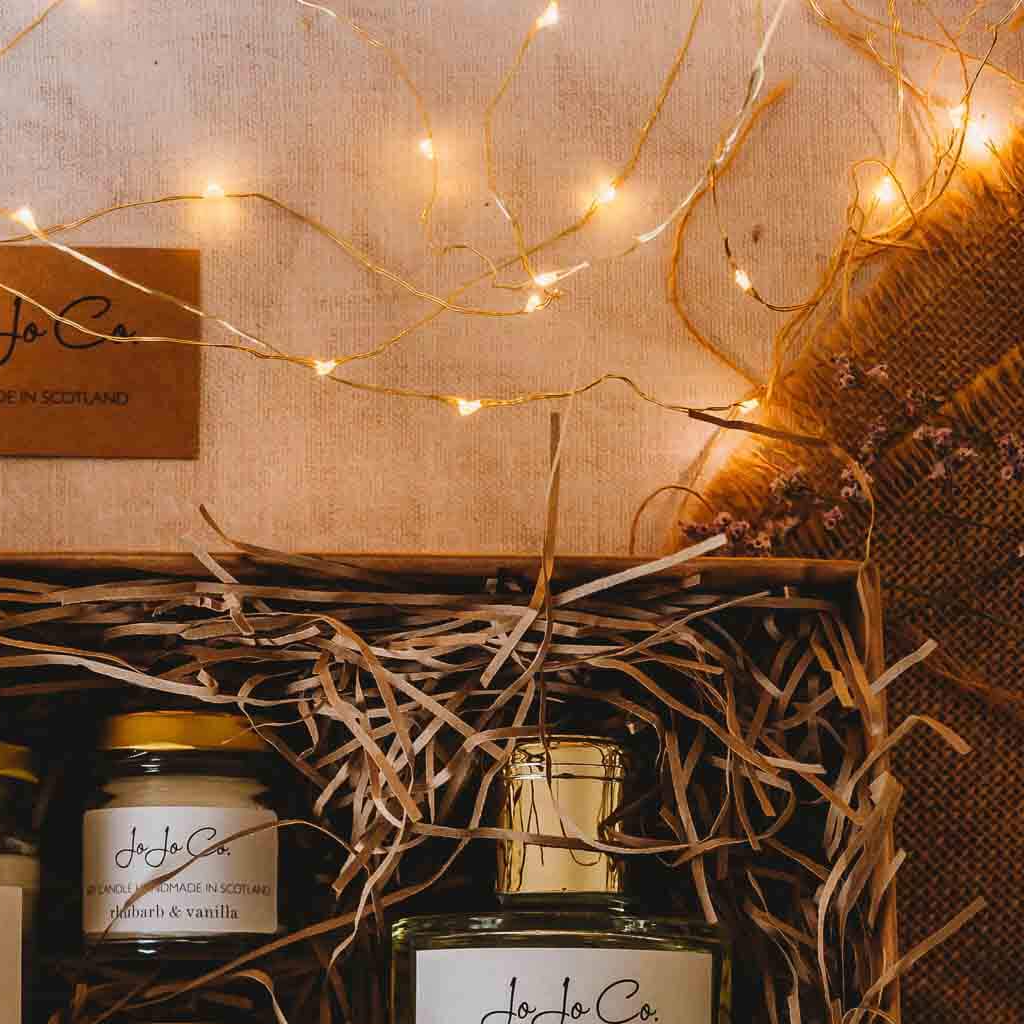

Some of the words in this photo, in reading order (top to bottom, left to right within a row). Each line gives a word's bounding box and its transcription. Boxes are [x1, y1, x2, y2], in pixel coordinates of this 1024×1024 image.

[18, 390, 36, 404] IN
[42, 391, 129, 406] SCOTLAND
[205, 883, 217, 895] IN
[220, 883, 271, 897] SCOTLAND
[110, 903, 164, 920] rhubarb
[168, 904, 182, 919] &
[186, 904, 240, 920] vanilla
